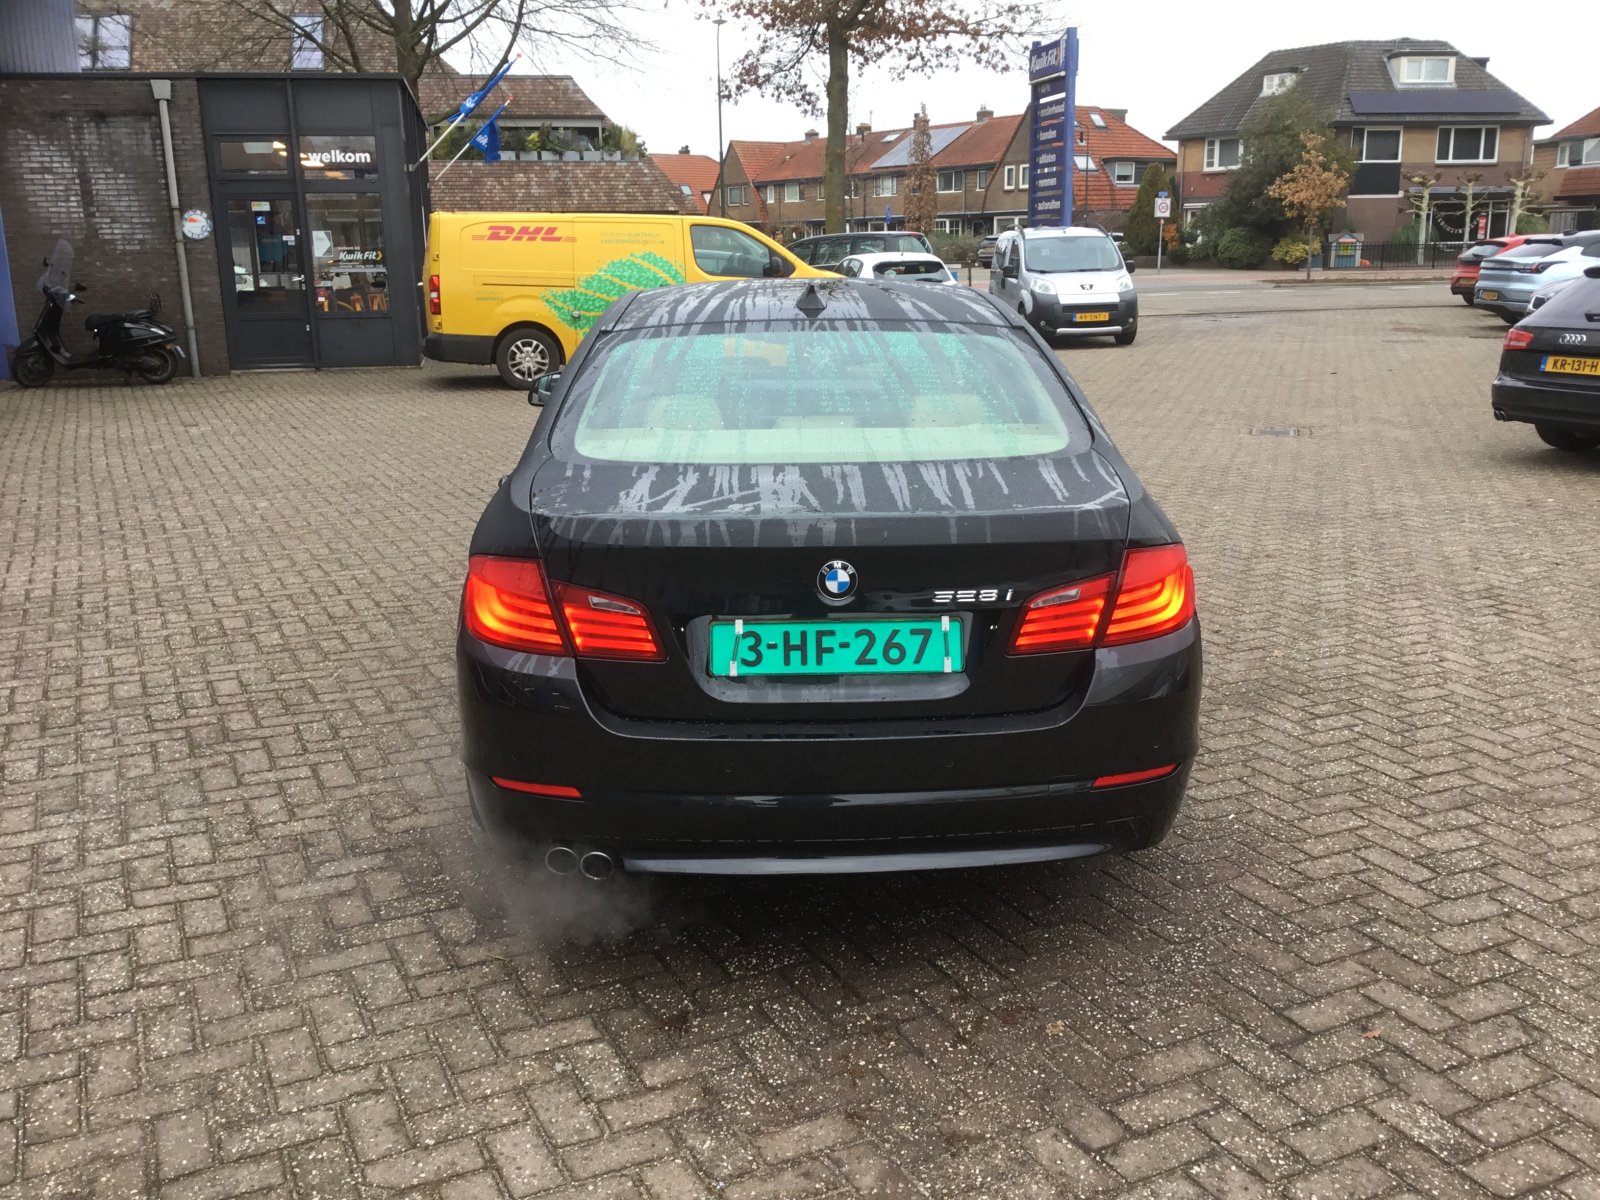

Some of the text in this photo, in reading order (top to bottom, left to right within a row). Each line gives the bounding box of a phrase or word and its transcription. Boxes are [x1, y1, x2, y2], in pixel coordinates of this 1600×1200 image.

[1040, 101, 1065, 117] onderhoud
[1039, 128, 1056, 140] banden
[308, 149, 371, 163] welkom
[1038, 152, 1056, 164] uitlaten
[1038, 177, 1057, 187] remmen
[1037, 199, 1061, 210] autoruiten
[486, 225, 564, 242] DHL
[339, 250, 377, 261] Kwik Fit
[1552, 358, 1599, 373] KR-131-H
[821, 561, 855, 575] BMW
[740, 628, 933, 667] 3-HF-267
